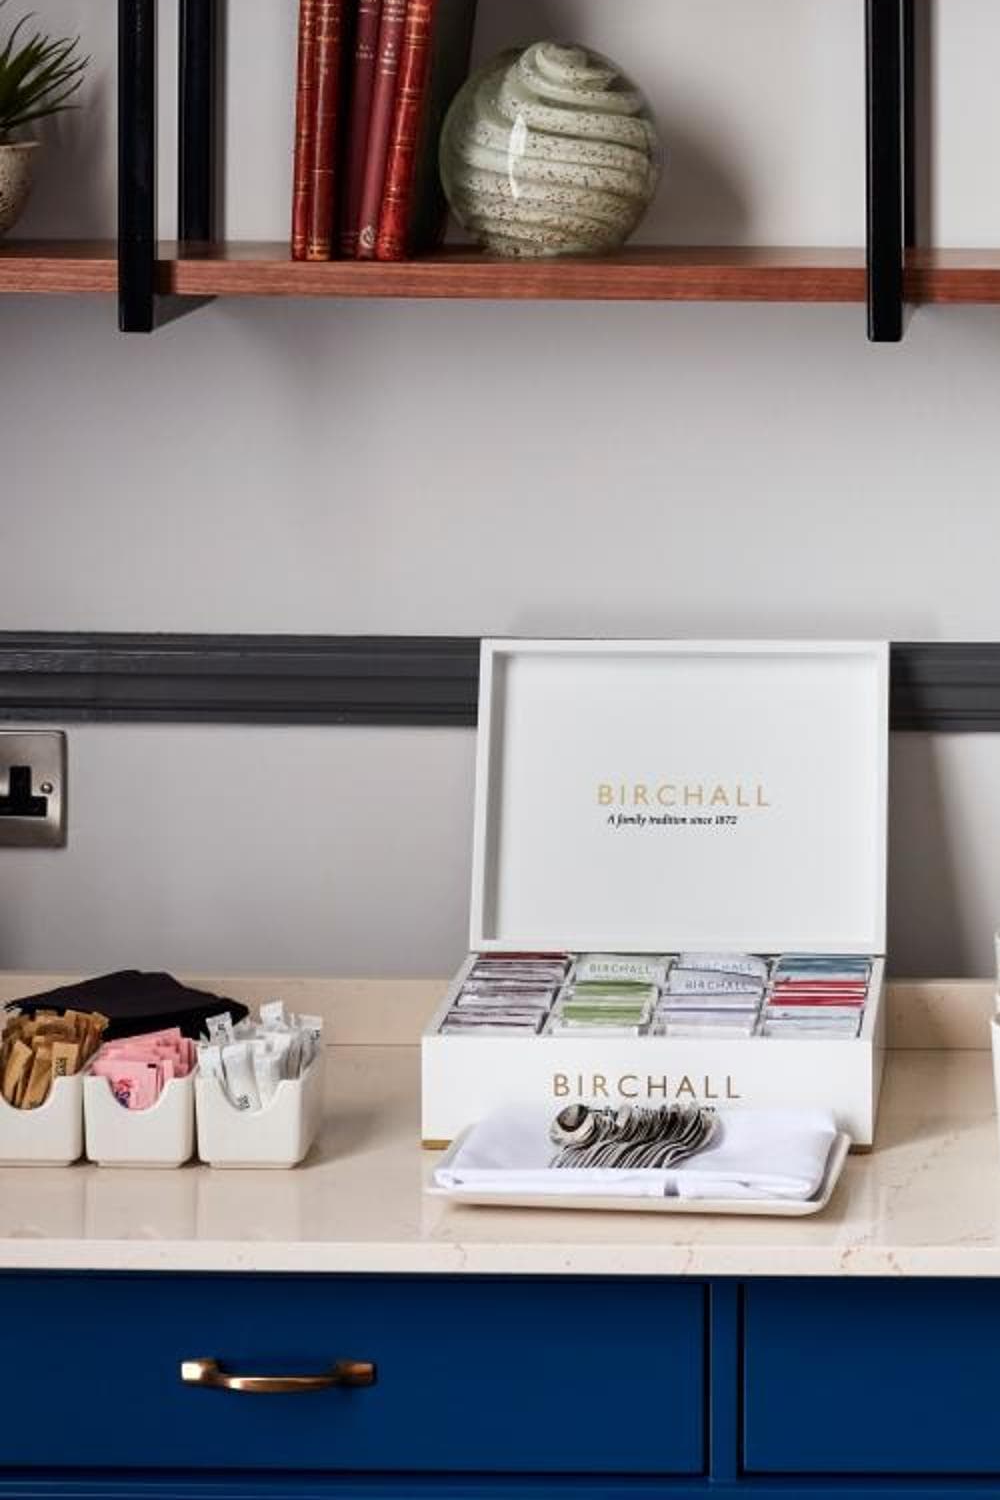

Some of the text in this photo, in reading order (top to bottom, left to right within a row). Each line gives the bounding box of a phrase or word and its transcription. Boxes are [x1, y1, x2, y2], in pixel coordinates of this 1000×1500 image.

[598, 784, 770, 807] BIRCHALL
[607, 813, 738, 828] A family tradition since 1872
[553, 1074, 741, 1099] BIRCHALL
